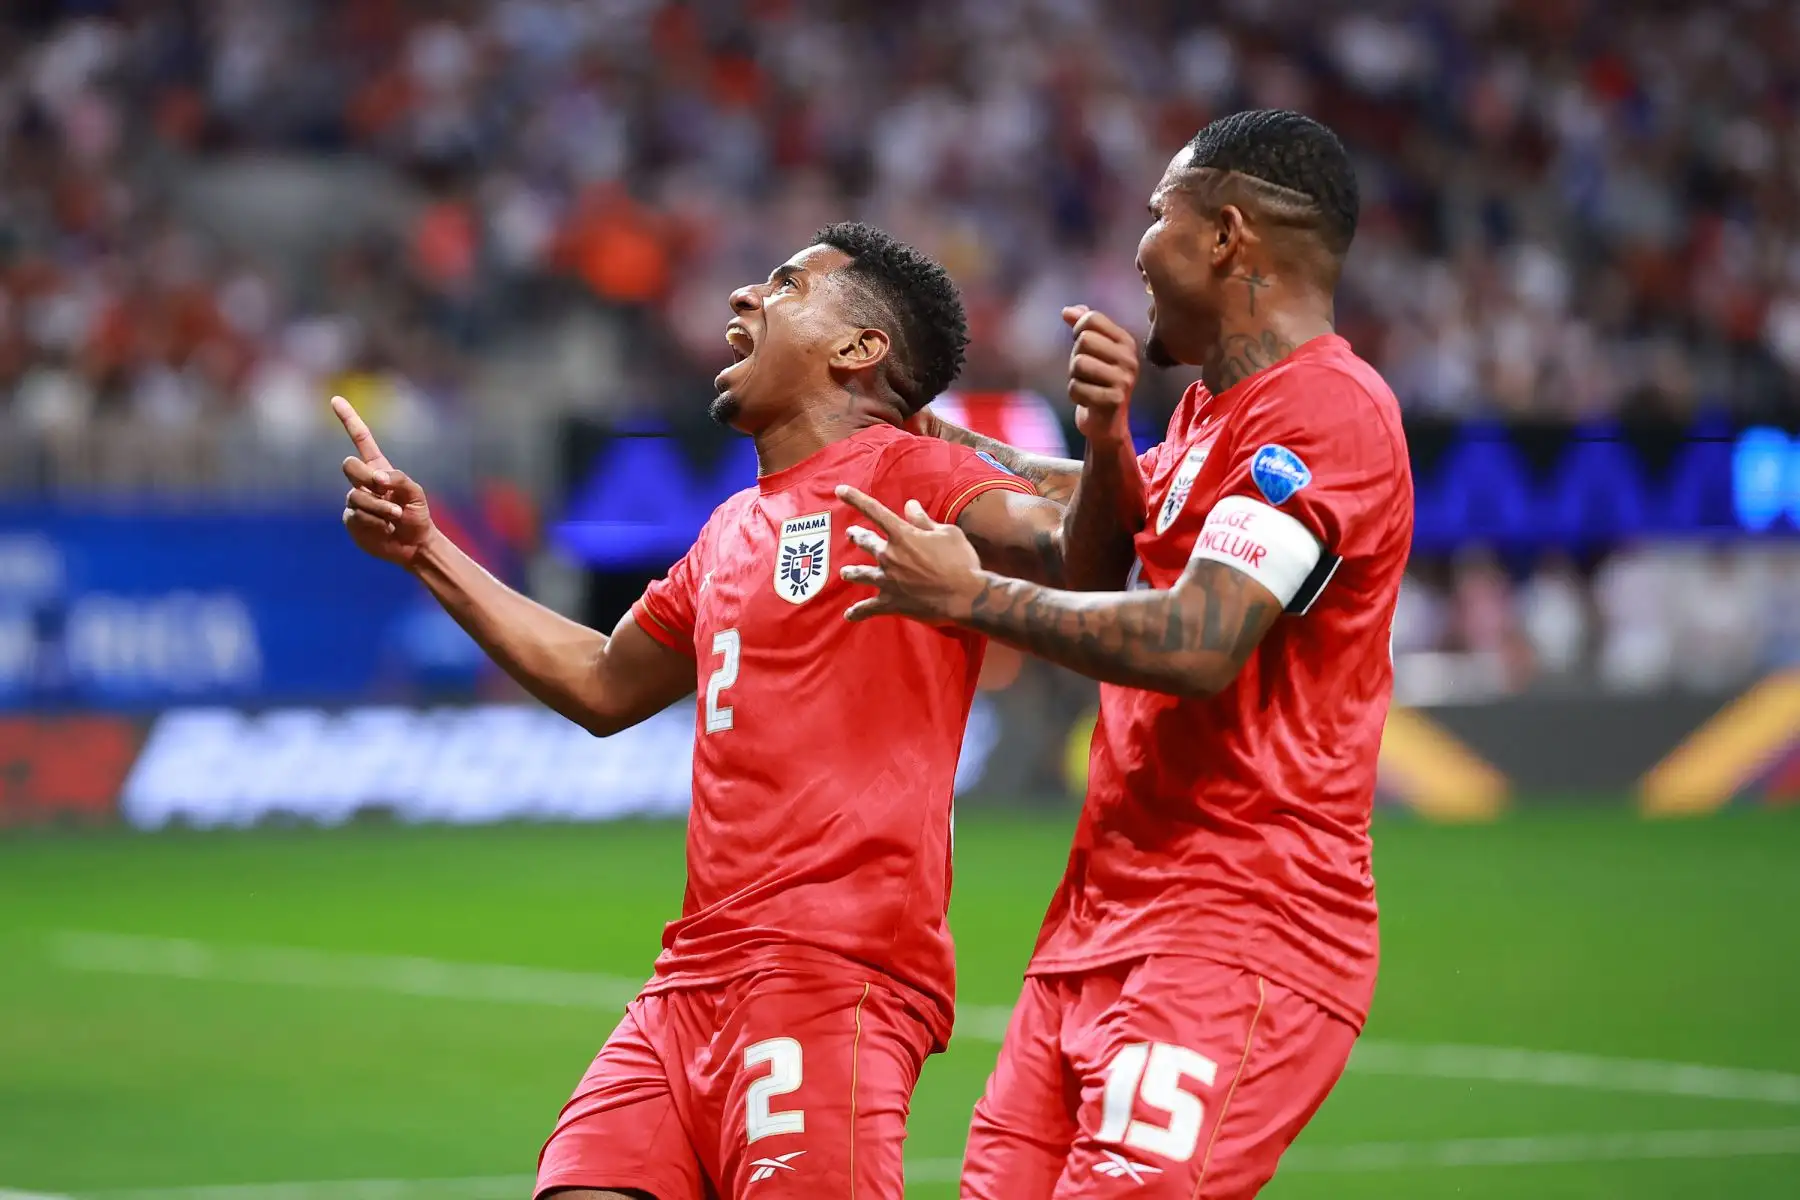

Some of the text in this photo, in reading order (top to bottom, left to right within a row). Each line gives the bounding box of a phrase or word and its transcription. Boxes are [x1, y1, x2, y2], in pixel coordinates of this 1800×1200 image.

[786, 516, 826, 533] PANAMÁ
[1199, 530, 1267, 568] NCLUIR
[1208, 510, 1257, 530] LIGE
[706, 628, 741, 735] 2
[744, 1037, 804, 1145] 2
[1093, 1041, 1217, 1162] 15
